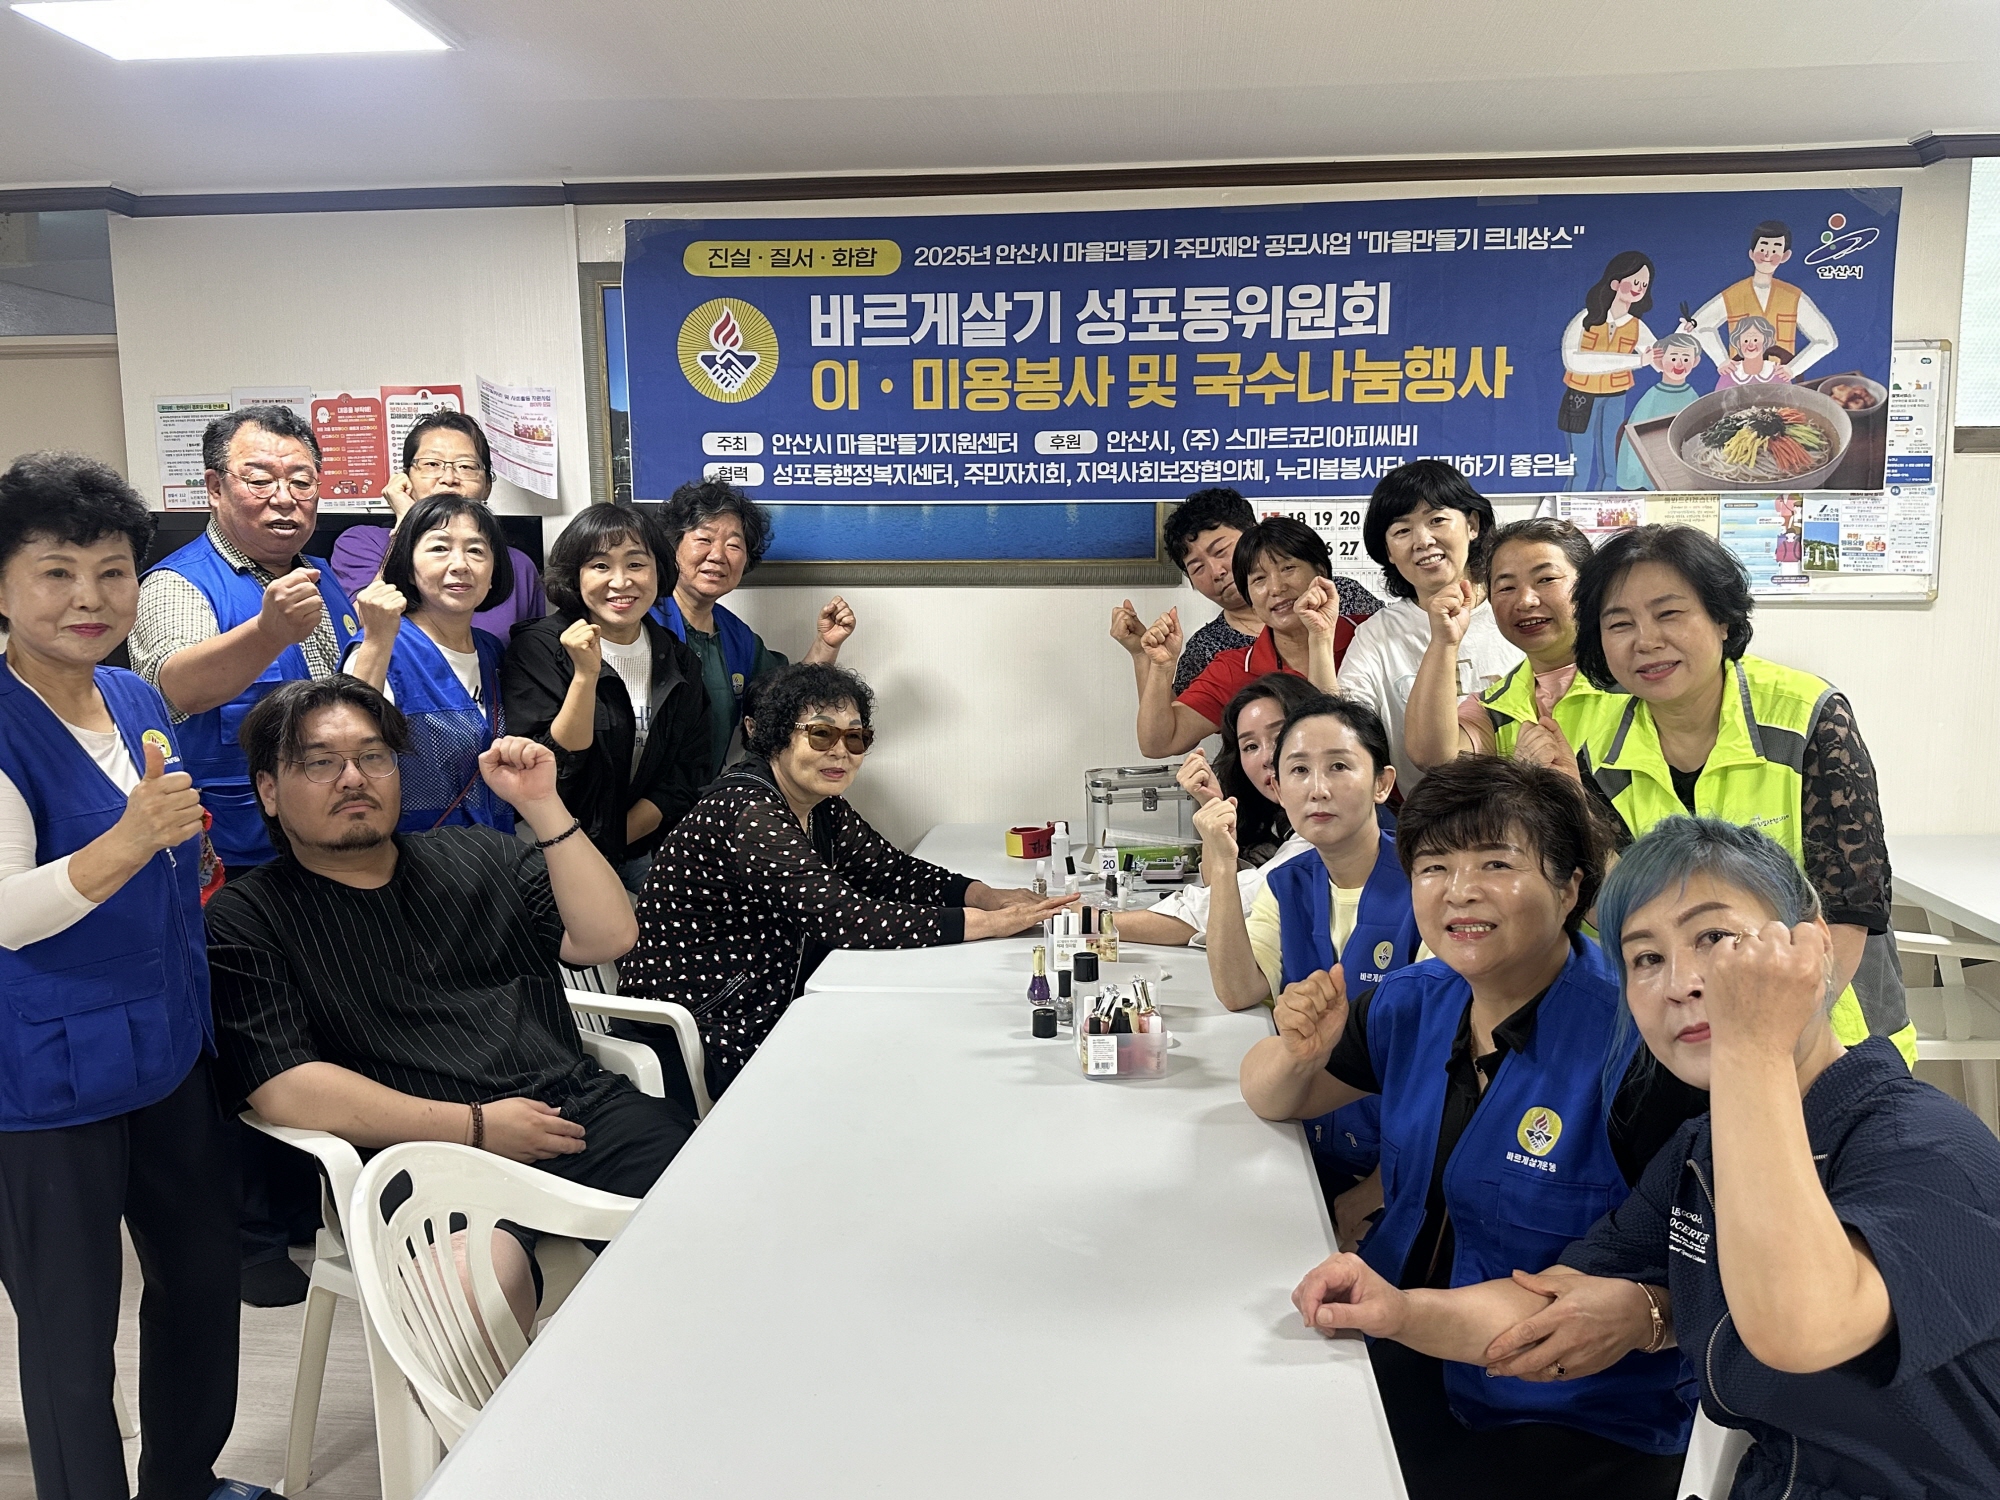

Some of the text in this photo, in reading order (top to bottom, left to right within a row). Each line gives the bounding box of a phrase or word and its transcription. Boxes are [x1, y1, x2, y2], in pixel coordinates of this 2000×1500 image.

[708, 247, 751, 268] 진실
[770, 247, 814, 268] 질서
[832, 247, 878, 268] 화합
[914, 225, 1586, 267] 2025년 안산시 마을만들기 주민제안 공모사업 "마을만들기 르네상스"
[1817, 265, 1863, 279] 안산시
[810, 280, 1391, 347] 바르게살기 성포동위원회
[913, 355, 1115, 412] 미용봉사
[1127, 353, 1177, 409] 및
[1193, 345, 1514, 408] 국수나눔행사
[717, 432, 1018, 455] 주최 안산시 마을만들기지원센터
[1050, 424, 1418, 454] 후원 안산시, (주) 스마트코리아피씨비
[718, 466, 748, 482] 협력
[773, 462, 959, 488] 성포동행정복지센터,
[963, 461, 1072, 487] 주민자치회,
[1076, 459, 1270, 484] 지역사회보장협의체,
[1510, 453, 1577, 477] 좋은날
[1314, 512, 1333, 526] 19
[1340, 511, 1360, 526] 20
[1339, 541, 1360, 556] 27
[1102, 860, 1116, 870] 20
